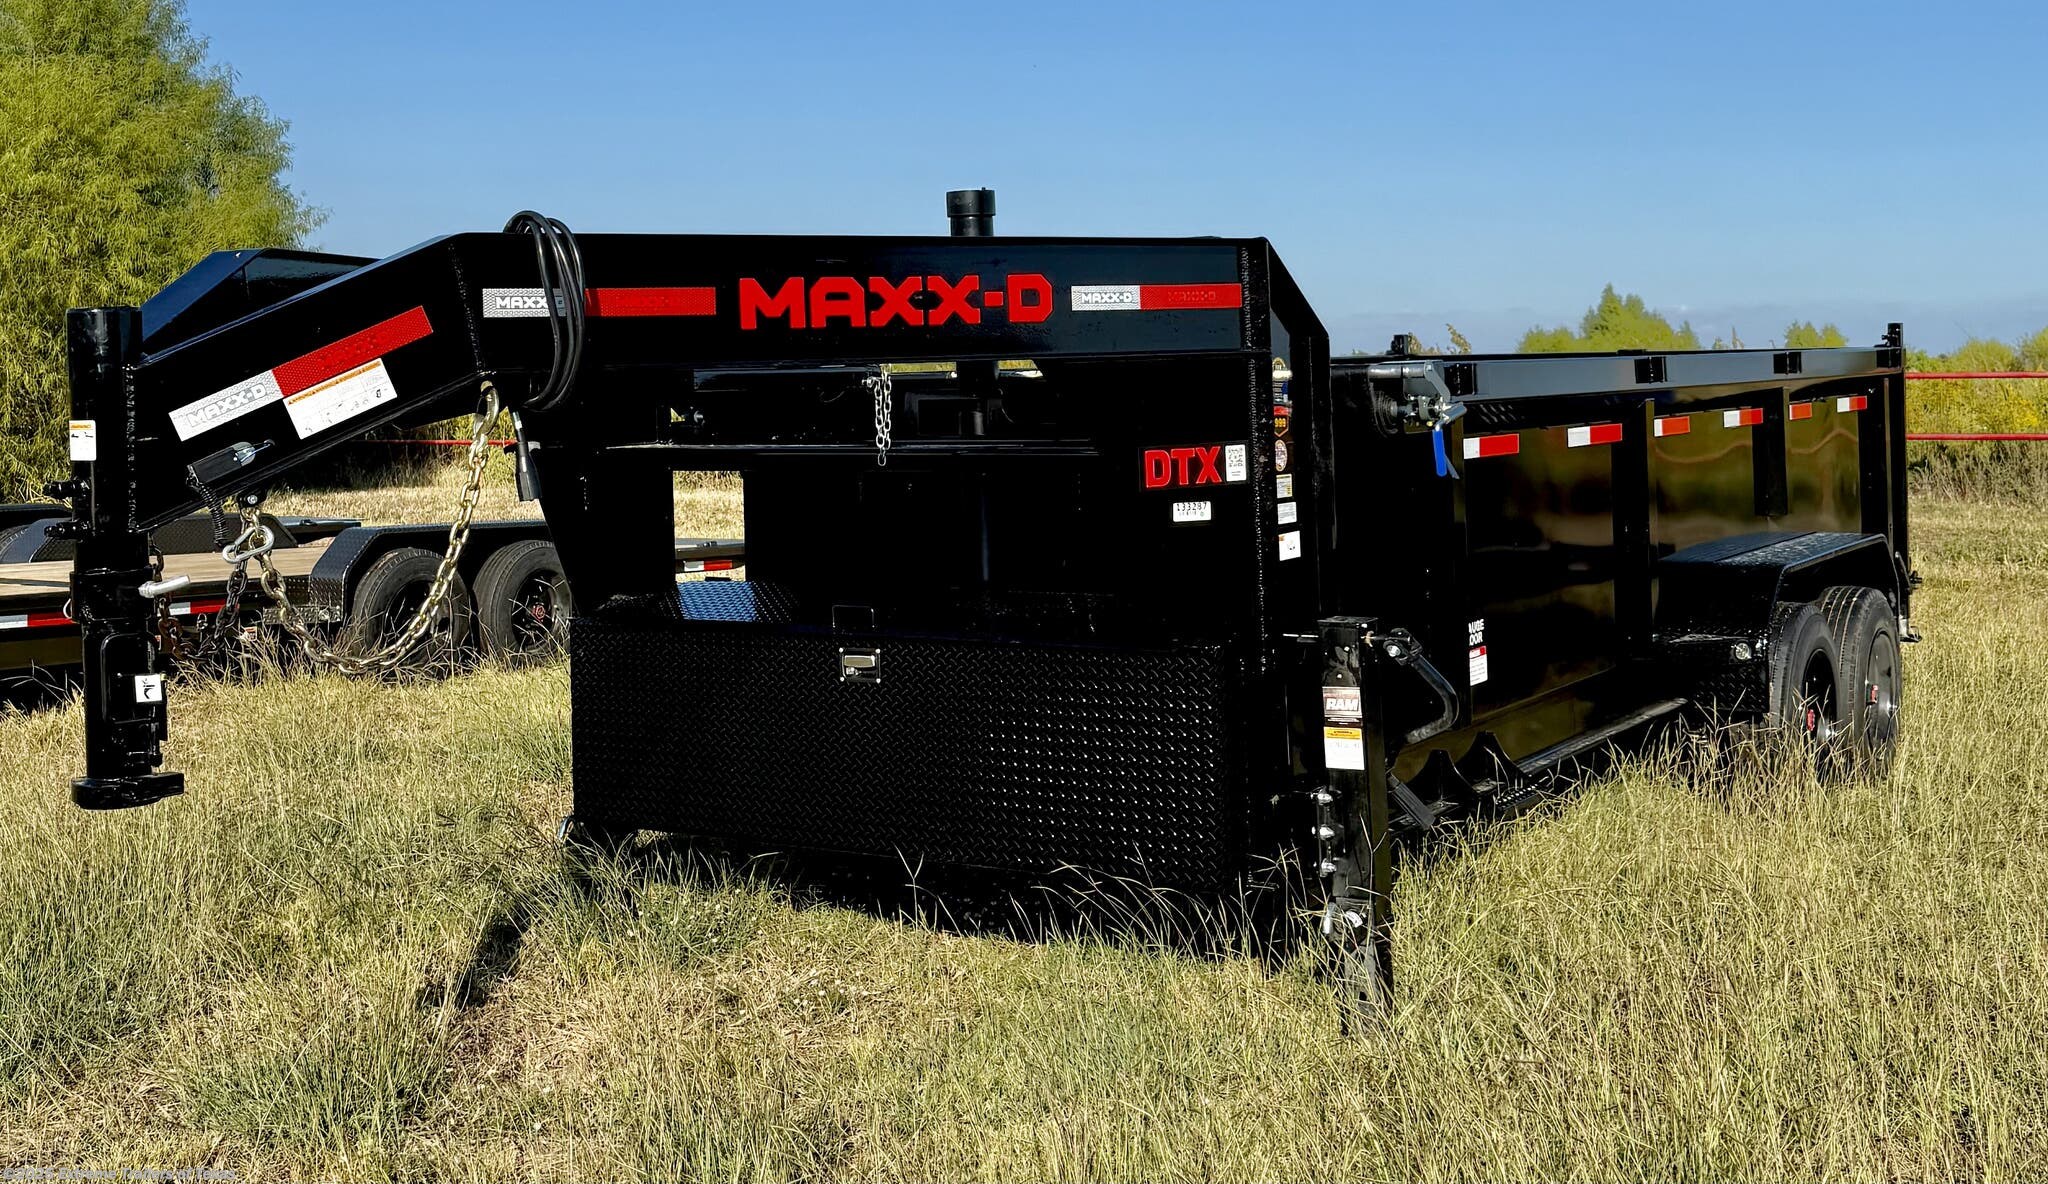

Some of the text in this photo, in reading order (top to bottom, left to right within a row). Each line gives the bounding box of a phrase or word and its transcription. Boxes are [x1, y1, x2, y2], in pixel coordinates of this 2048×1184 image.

[739, 273, 1054, 330] MAXX-D
[1080, 292, 1133, 304] MAXX-D
[185, 383, 269, 428] MAXX-D
[1144, 445, 1223, 489] DTX
[1326, 698, 1360, 711] RAM
